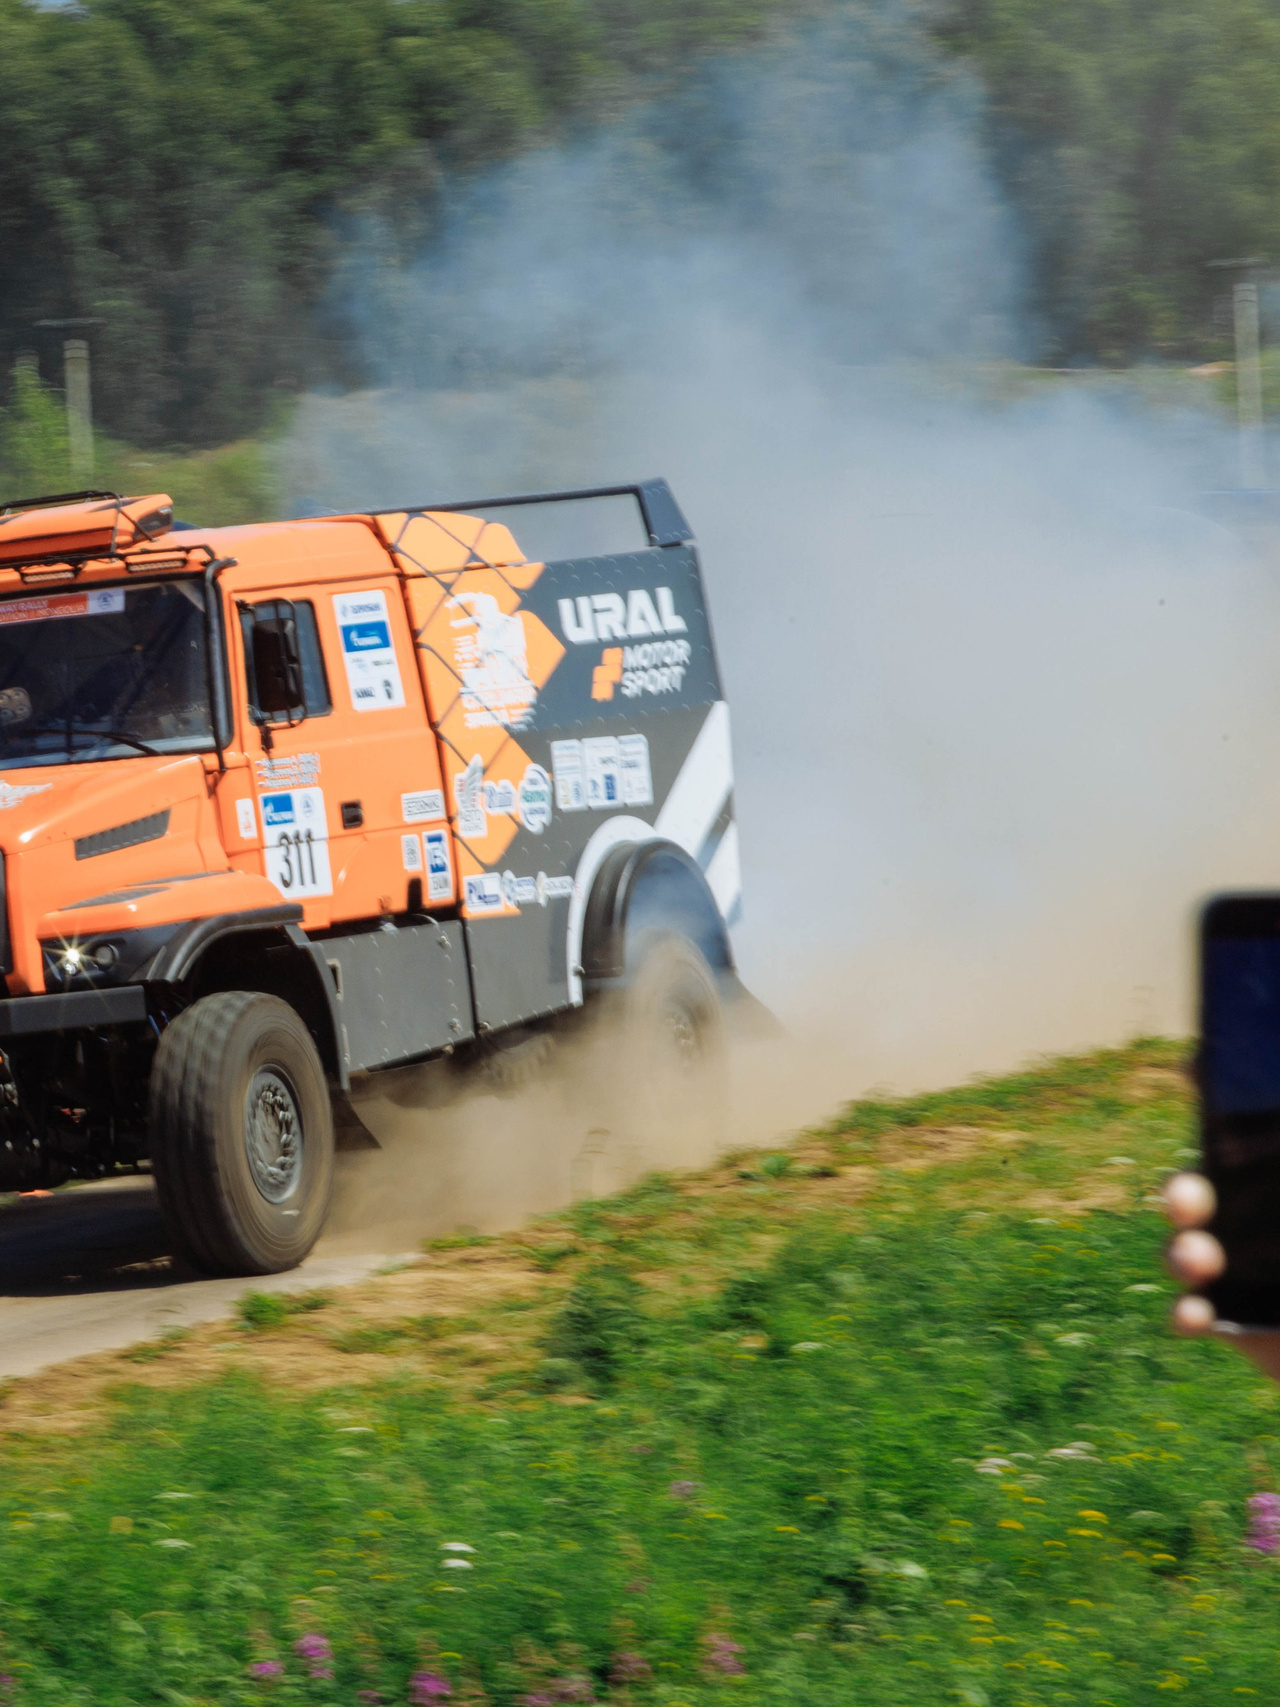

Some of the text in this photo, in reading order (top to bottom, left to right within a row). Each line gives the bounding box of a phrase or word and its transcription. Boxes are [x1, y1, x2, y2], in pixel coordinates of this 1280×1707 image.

[557, 587, 688, 645] URAL
[623, 639, 692, 671] MOTOR
[621, 665, 687, 698] SPORT
[279, 828, 317, 888] 311
